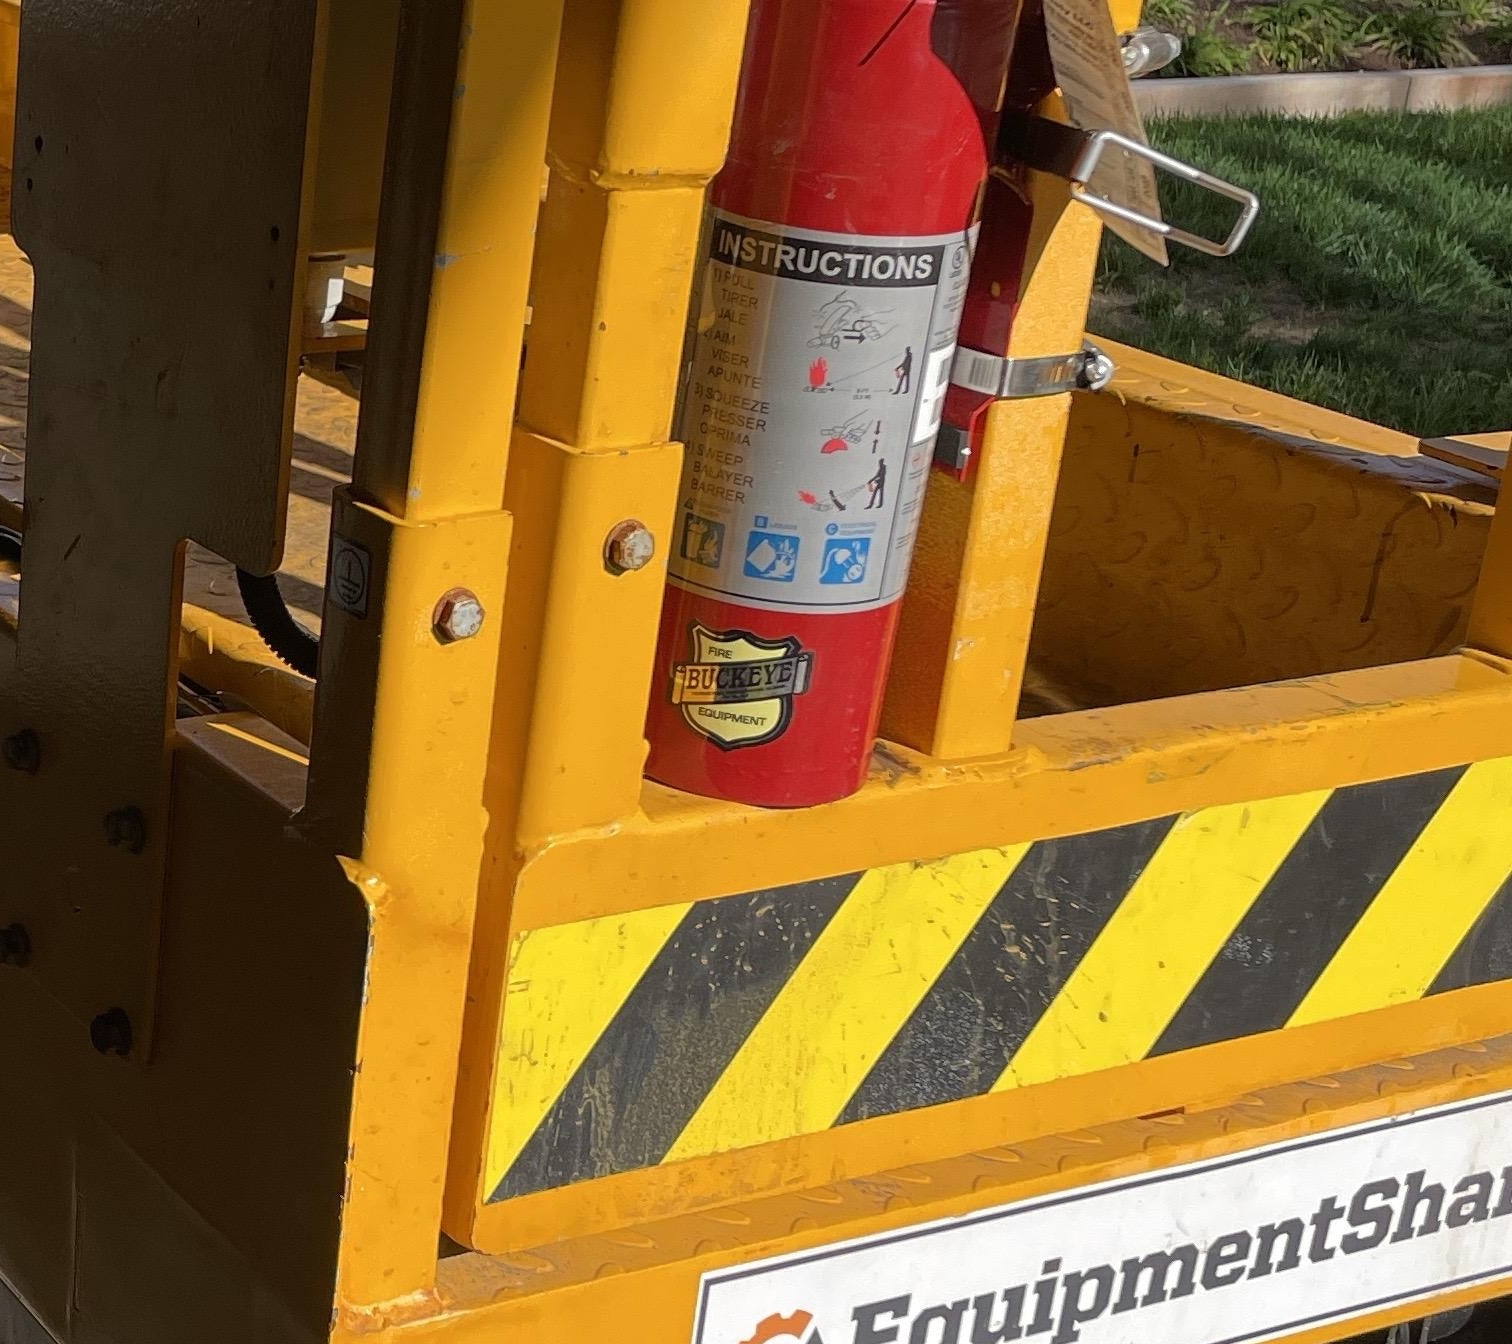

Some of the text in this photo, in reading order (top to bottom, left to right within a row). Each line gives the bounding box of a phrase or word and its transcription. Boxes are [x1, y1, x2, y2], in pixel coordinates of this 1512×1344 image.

[719, 229, 934, 281] INSTRUCTIONS
[721, 288, 760, 308] TIRER
[713, 329, 736, 344] AIM
[712, 349, 750, 369] VISER
[707, 365, 763, 390] APUNTE
[705, 387, 770, 414] SQUEEZE
[702, 405, 767, 432] PRESSER
[699, 422, 751, 447] OPRIMA
[696, 442, 744, 466] SWEEP
[692, 458, 754, 488] BALAYER
[690, 479, 746, 505] BARRER
[707, 646, 734, 659] FIRE
[686, 662, 794, 690] BUCKEYE
[697, 706, 769, 727] EQUIPMENT
